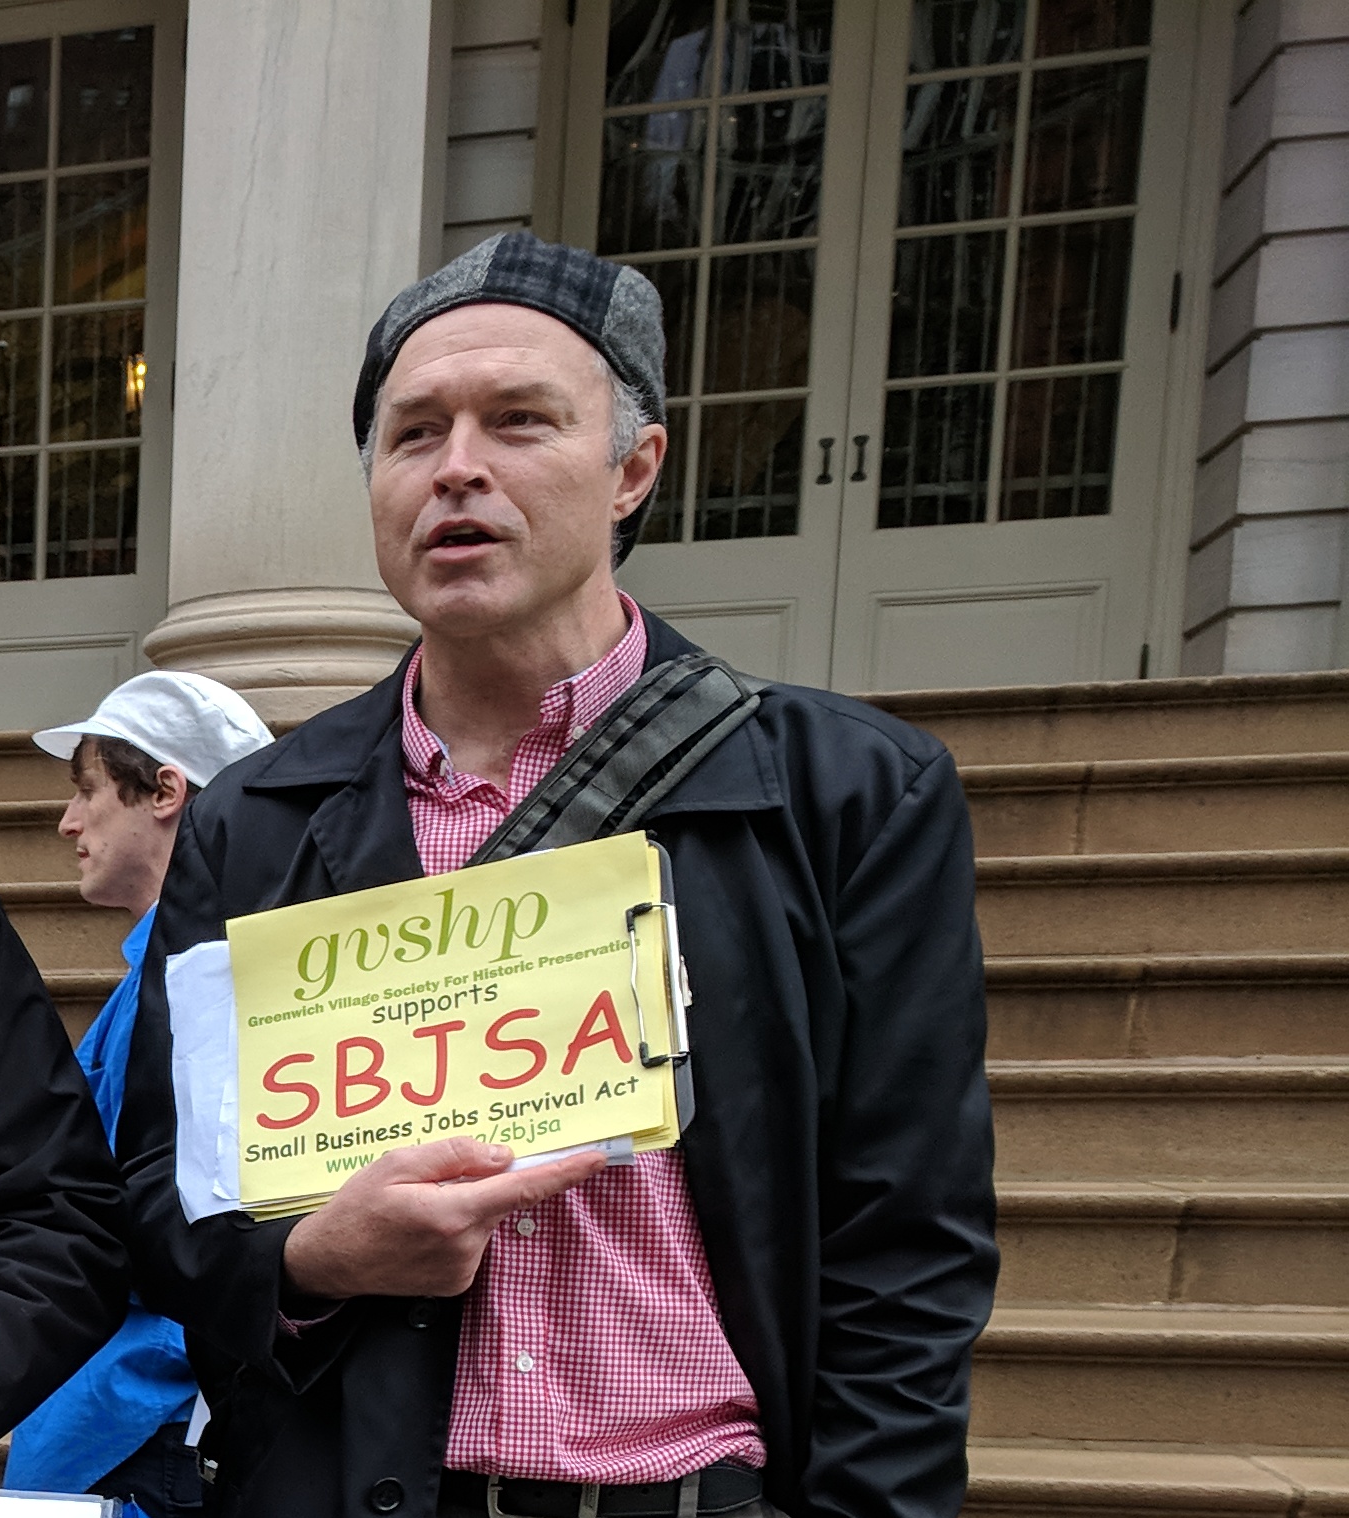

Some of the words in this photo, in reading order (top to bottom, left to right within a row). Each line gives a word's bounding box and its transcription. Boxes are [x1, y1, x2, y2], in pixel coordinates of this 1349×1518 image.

[293, 887, 549, 1001] gvshp
[248, 1002, 325, 1028] Greenwich
[328, 993, 380, 1011] Village
[383, 979, 440, 1000] Society
[444, 975, 469, 988] For
[473, 960, 534, 982] Historic
[372, 982, 499, 1026] supports
[256, 989, 634, 1130] SBJSA
[244, 1136, 307, 1163] Small
[316, 1120, 413, 1152] Business
[422, 1109, 479, 1133] Jobs
[488, 1085, 585, 1121] Survival
[595, 1075, 640, 1101] Act
